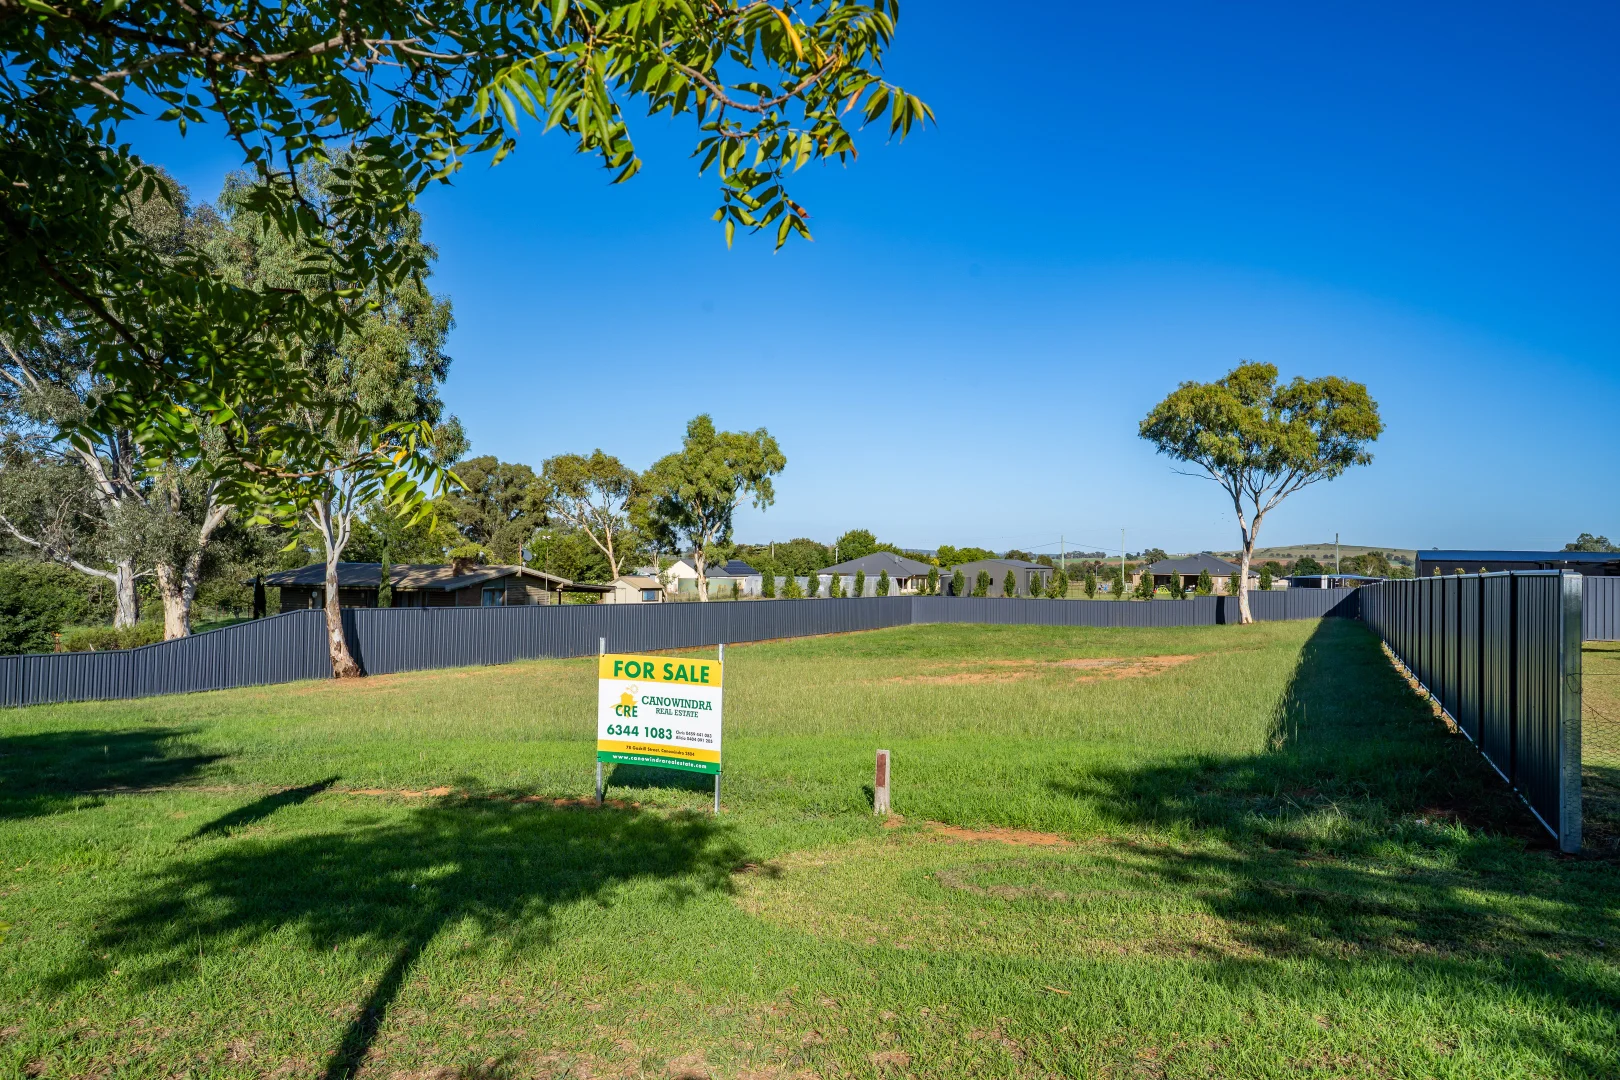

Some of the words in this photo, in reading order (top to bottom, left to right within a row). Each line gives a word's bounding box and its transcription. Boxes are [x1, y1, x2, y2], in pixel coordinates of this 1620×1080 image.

[614, 660, 655, 679] FOR
[663, 663, 710, 683] SALE
[641, 695, 712, 711] CANOWINDRA
[615, 704, 638, 718] CRE
[656, 707, 673, 716] REAL
[674, 710, 699, 718] ESTATE
[606, 724, 639, 737] 6344
[644, 726, 673, 740] 1083
[661, 748, 684, 756] Canowindra
[612, 754, 707, 769] www.canowindrarealestate.com
